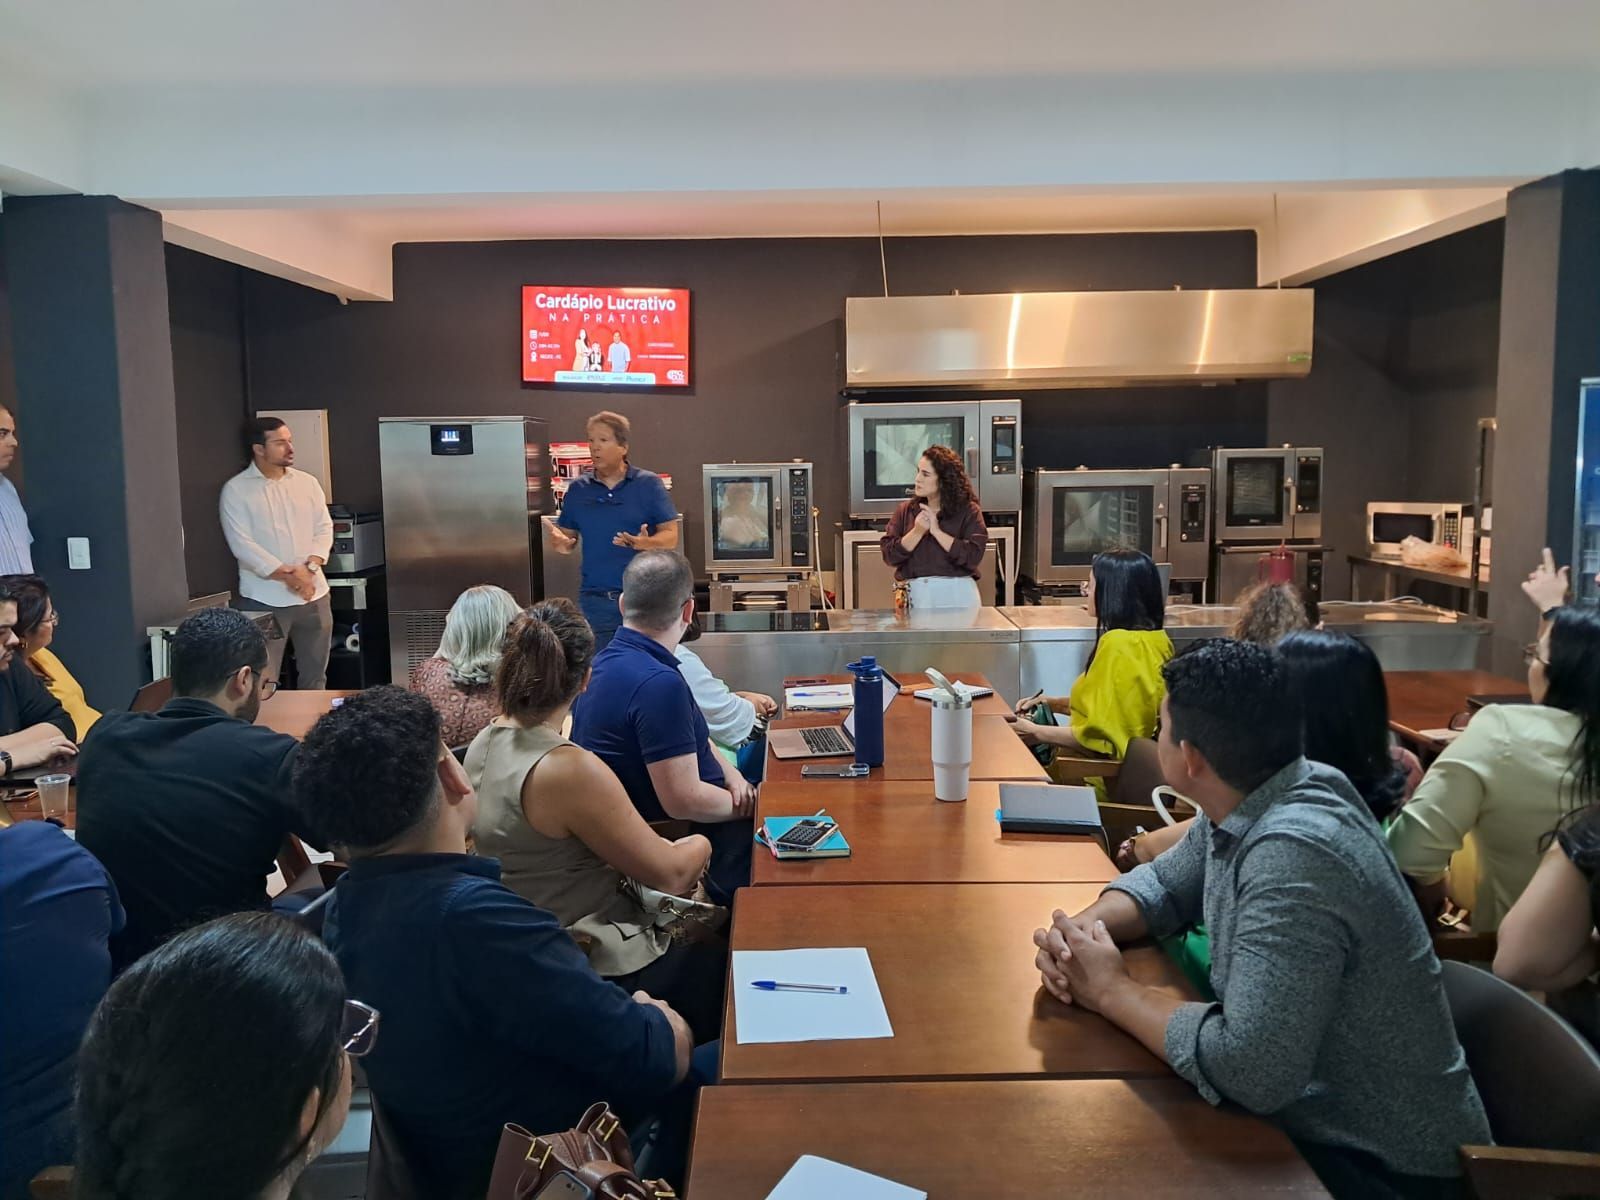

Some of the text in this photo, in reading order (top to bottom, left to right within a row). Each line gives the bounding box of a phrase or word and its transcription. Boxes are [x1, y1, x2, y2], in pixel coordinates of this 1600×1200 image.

[535, 293, 676, 311] Cardápio Lucrativo
[549, 312, 660, 324] NA PRÁTICA
